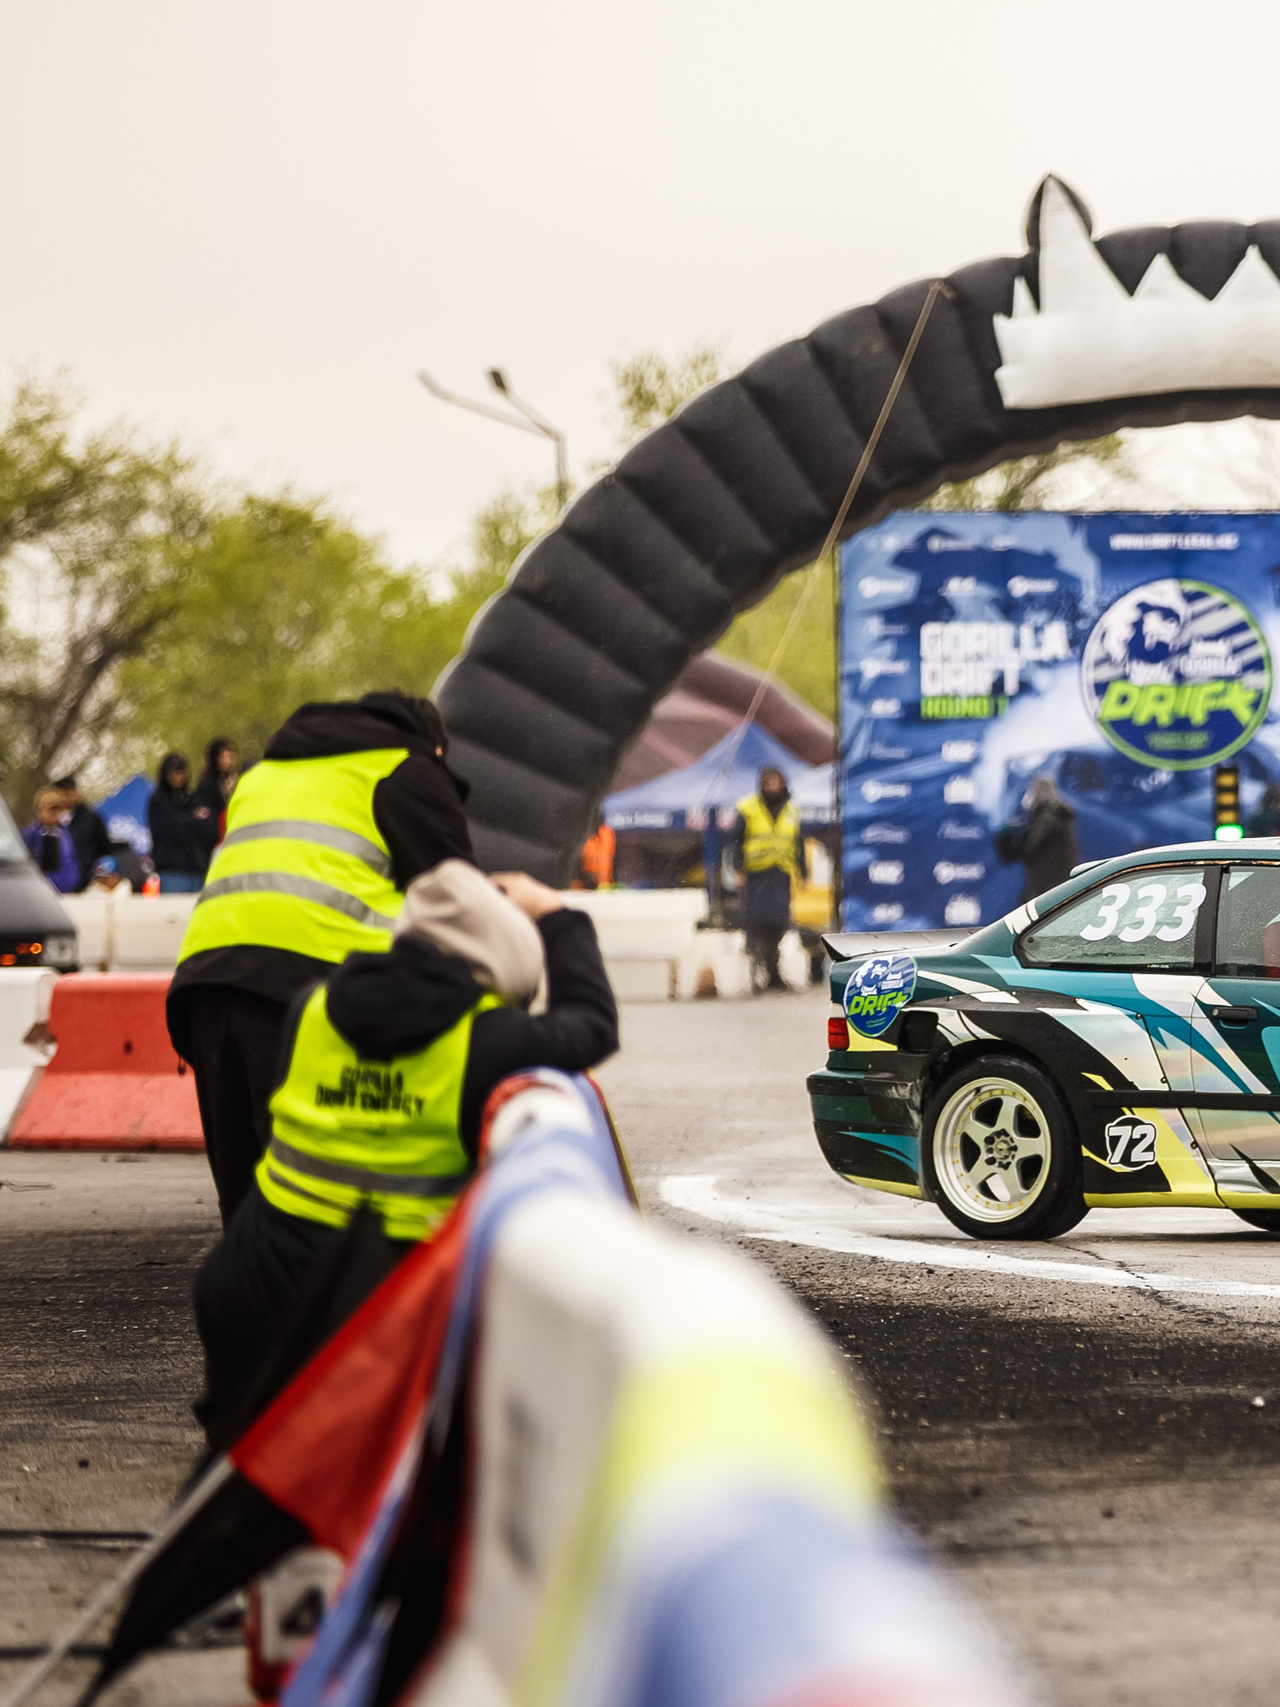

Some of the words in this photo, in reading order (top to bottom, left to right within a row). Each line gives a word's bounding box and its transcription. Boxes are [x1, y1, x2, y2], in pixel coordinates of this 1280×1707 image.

[920, 621, 1072, 661] GORILLA
[920, 660, 1020, 696] DRIFT
[920, 695, 994, 719] ROUND
[1080, 883, 1207, 942] 333
[1109, 1124, 1155, 1163] 72
